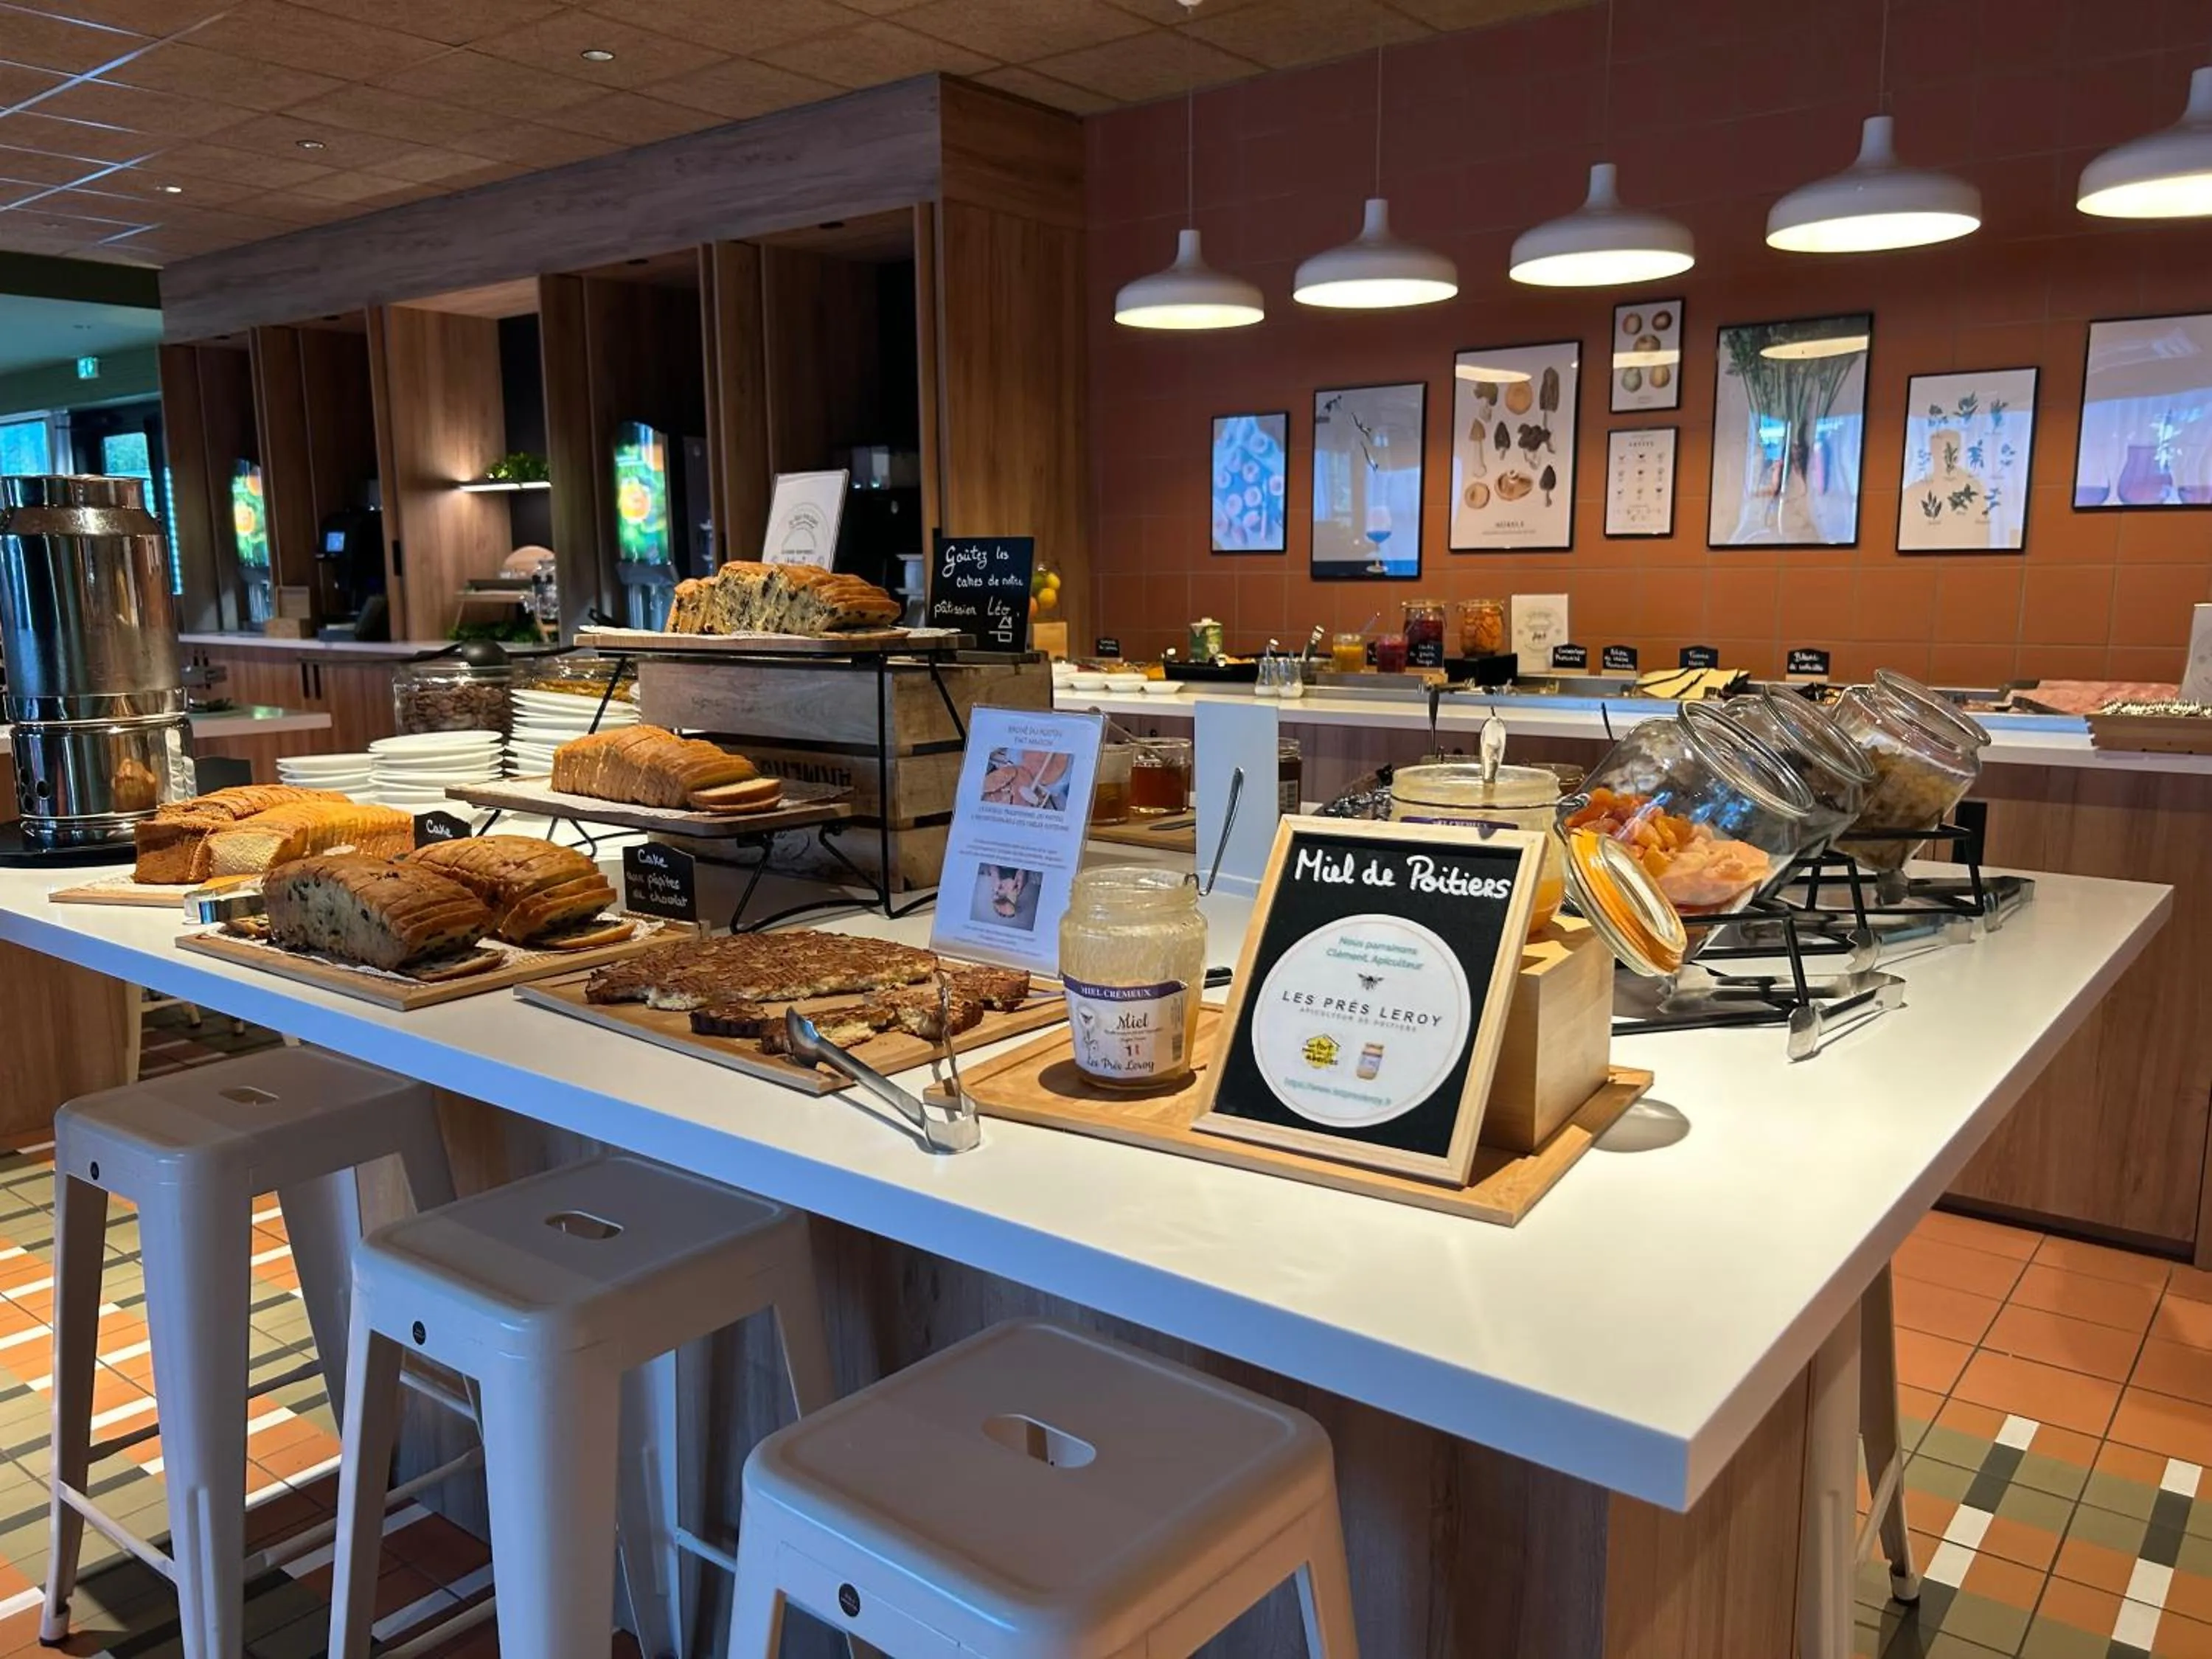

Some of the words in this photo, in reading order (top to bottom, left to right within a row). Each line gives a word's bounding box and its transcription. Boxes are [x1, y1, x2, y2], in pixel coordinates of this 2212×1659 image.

[942, 545, 988, 577] Goûtez
[996, 546, 1009, 560] les
[956, 574, 983, 588] cakes
[987, 575, 999, 587] de
[933, 599, 977, 619] pâtissier
[425, 819, 454, 838] Cake
[638, 849, 669, 868] Cake
[1295, 848, 1354, 884] Miel
[1362, 859, 1396, 887] de
[1406, 855, 1512, 899] Poitiers
[1371, 955, 1425, 970] Apiculteur
[1081, 985, 1102, 995] MIEL
[1282, 990, 1315, 1006] LES
[1380, 1007, 1443, 1026] LEROY
[1116, 1012, 1148, 1030] Miel
